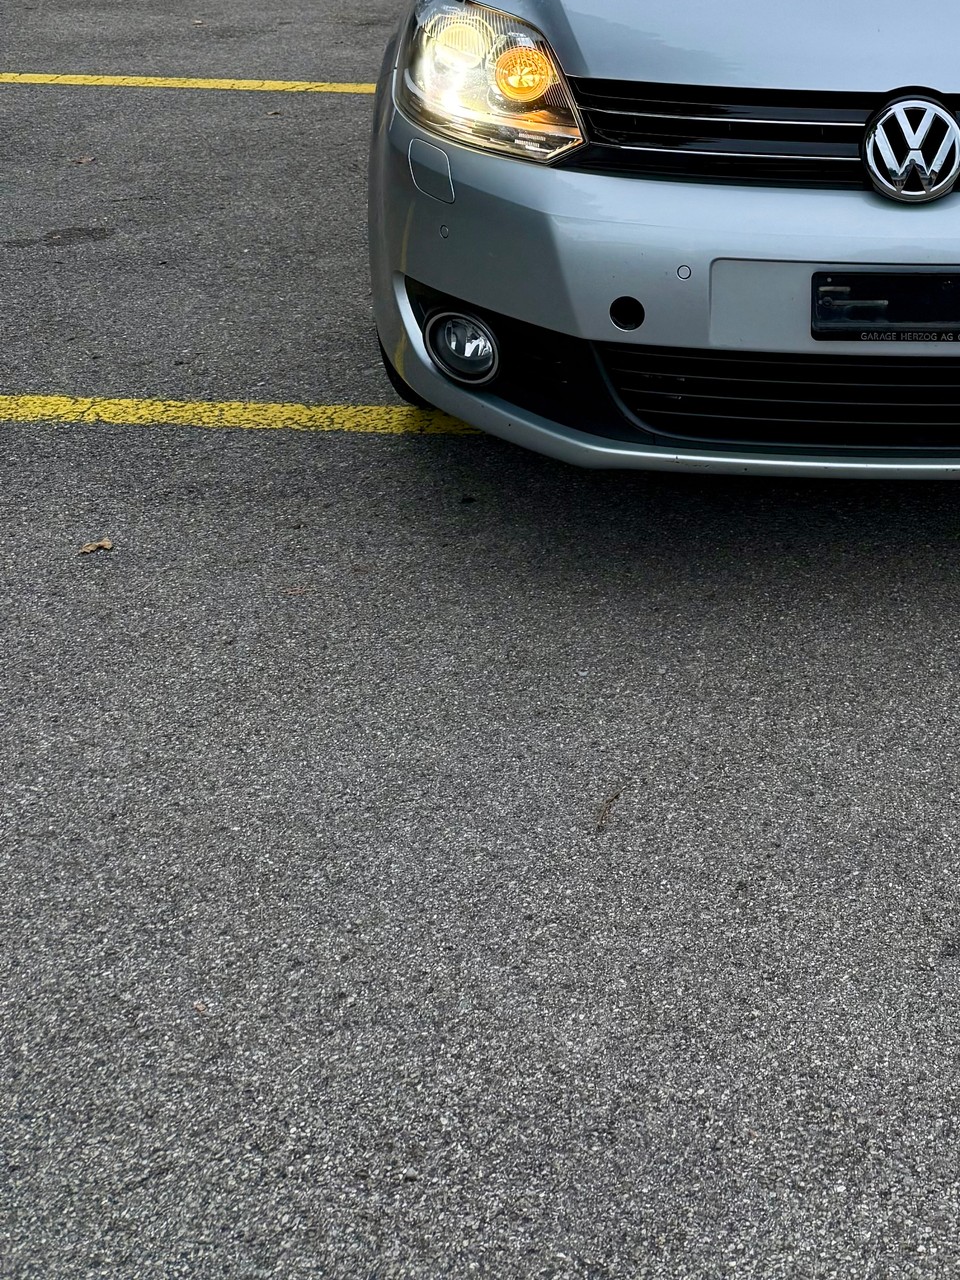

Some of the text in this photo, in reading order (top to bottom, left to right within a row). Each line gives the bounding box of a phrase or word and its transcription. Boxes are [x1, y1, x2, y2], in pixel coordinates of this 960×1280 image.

[860, 332, 897, 341] GARAGE
[900, 332, 938, 341] HERZOG
[940, 333, 954, 341] AG
